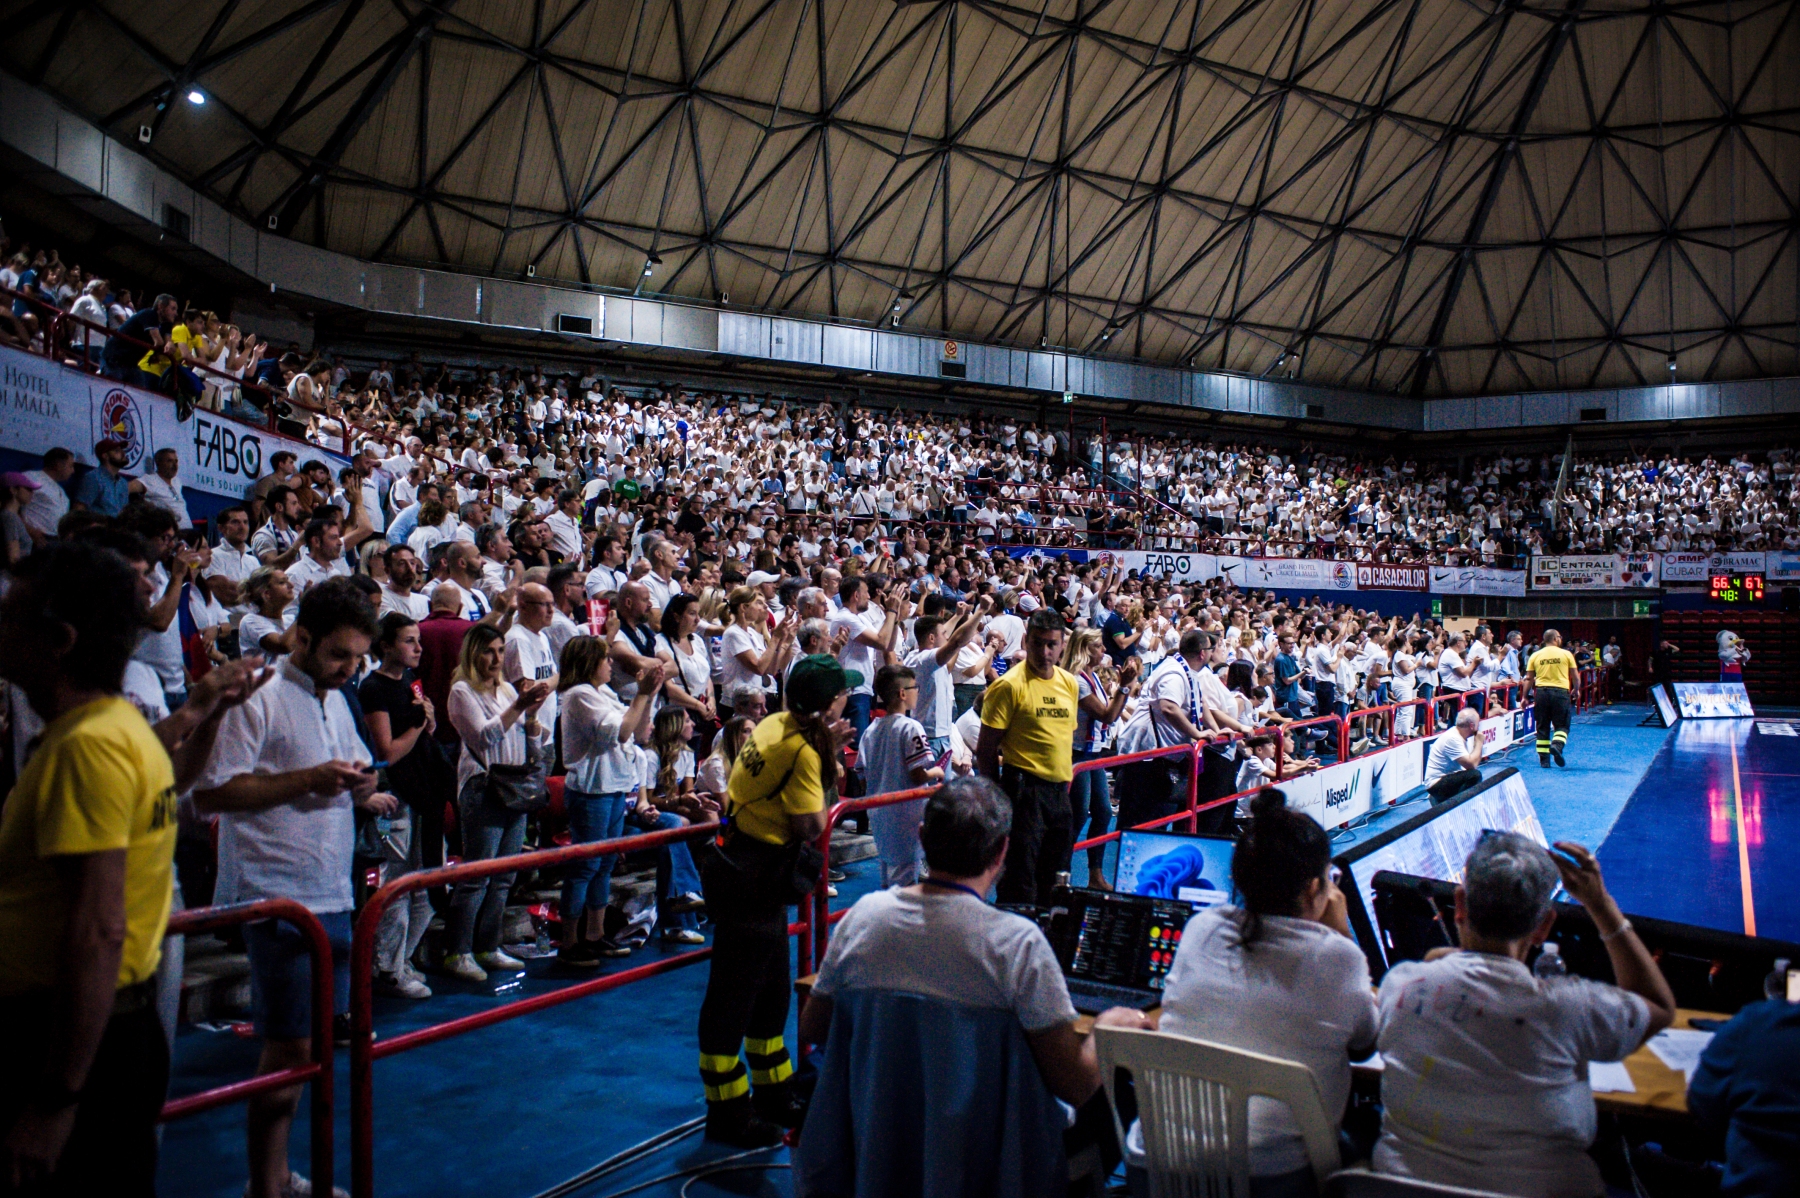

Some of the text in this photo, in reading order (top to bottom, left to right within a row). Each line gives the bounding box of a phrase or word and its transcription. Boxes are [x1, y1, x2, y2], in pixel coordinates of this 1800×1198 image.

[5, 365, 52, 397] HOTEL
[14, 391, 60, 420] MALTA
[193, 418, 262, 479] FABO
[196, 473, 247, 494] TAPE SOLUT
[1145, 554, 1191, 575] FABO
[1628, 562, 1648, 572] DNA
[1665, 566, 1703, 576] CUBAR
[1723, 557, 1761, 566] BRAMAC
[1372, 567, 1426, 588] CASACOLOR
[1042, 696, 1057, 705] ESAF
[1035, 707, 1070, 719] ANTINCENDIO
[1325, 782, 1349, 809] Alisped
